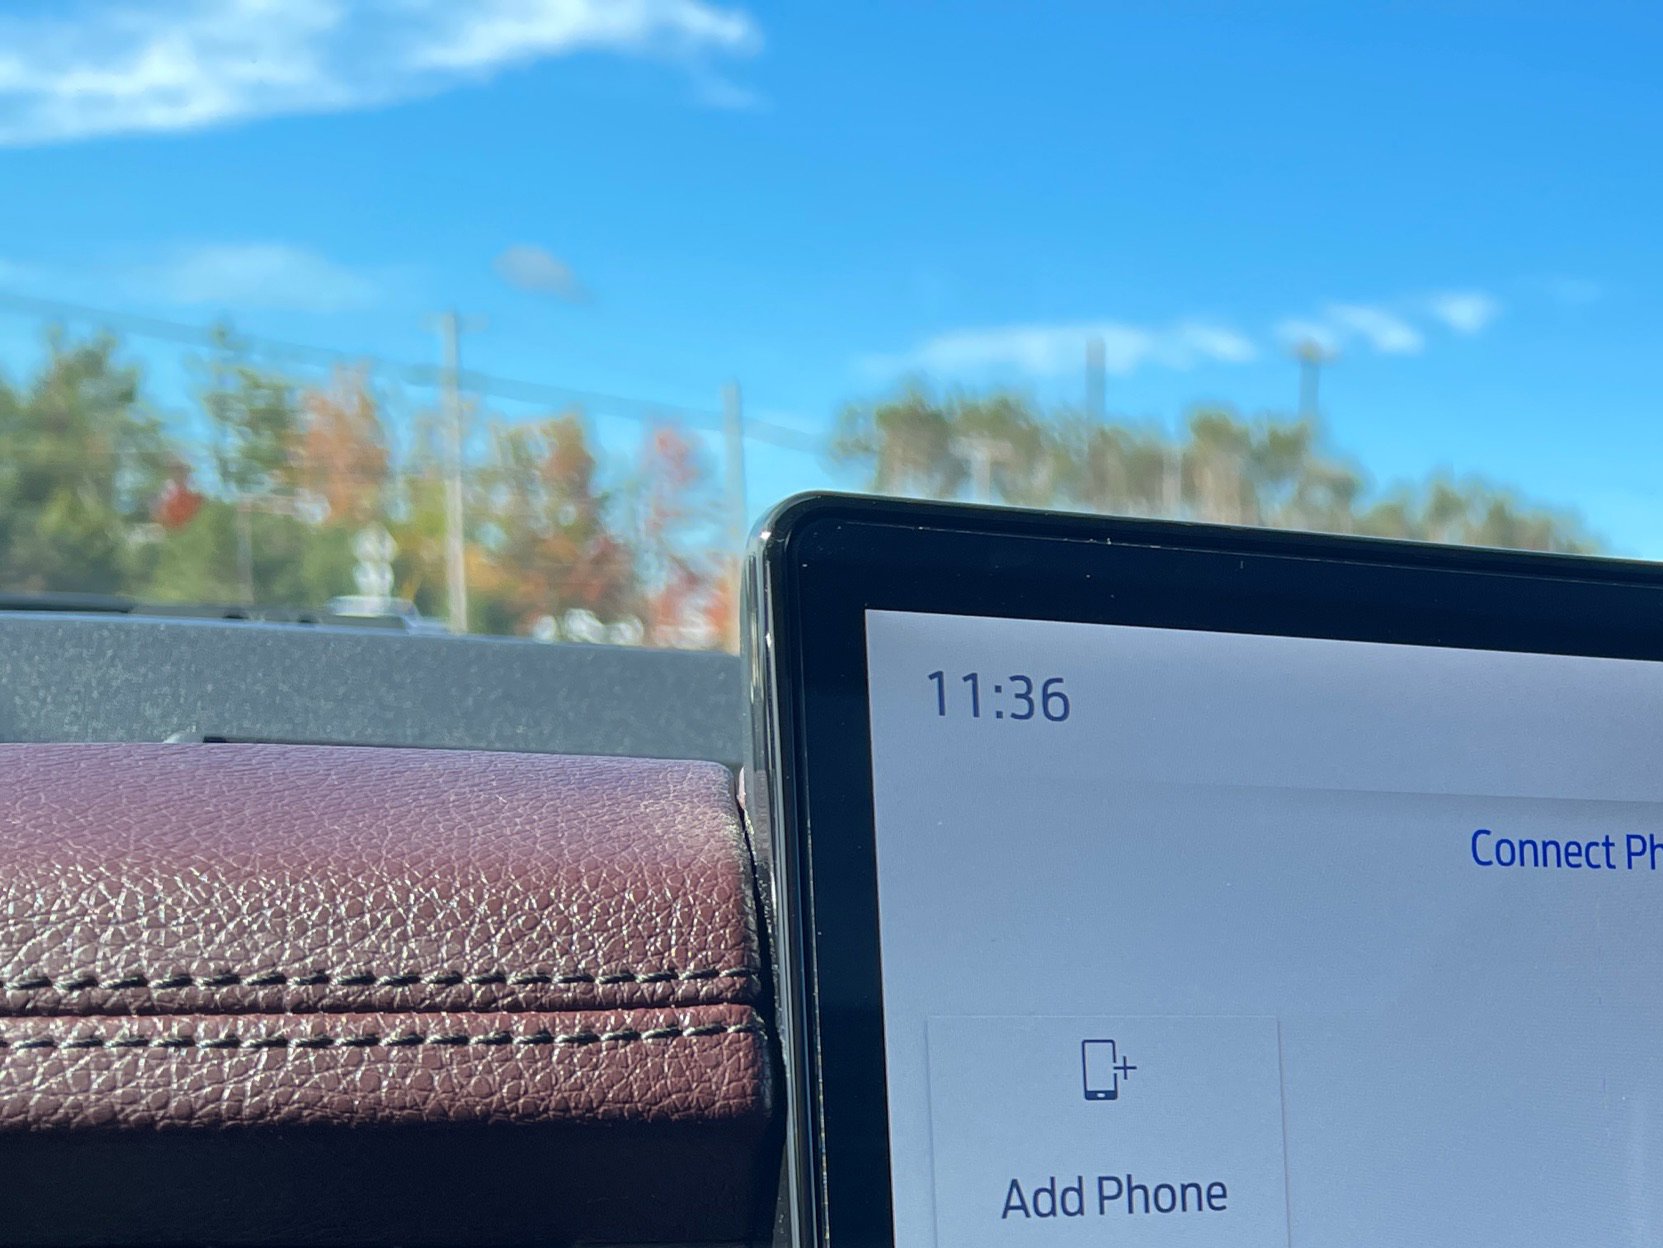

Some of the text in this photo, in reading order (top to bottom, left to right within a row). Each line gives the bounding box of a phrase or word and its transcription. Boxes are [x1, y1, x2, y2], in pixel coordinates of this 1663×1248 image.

[927, 670, 1071, 721] 11:36
[1470, 829, 1616, 870] Connect
[1001, 1174, 1228, 1220] Add Phone
